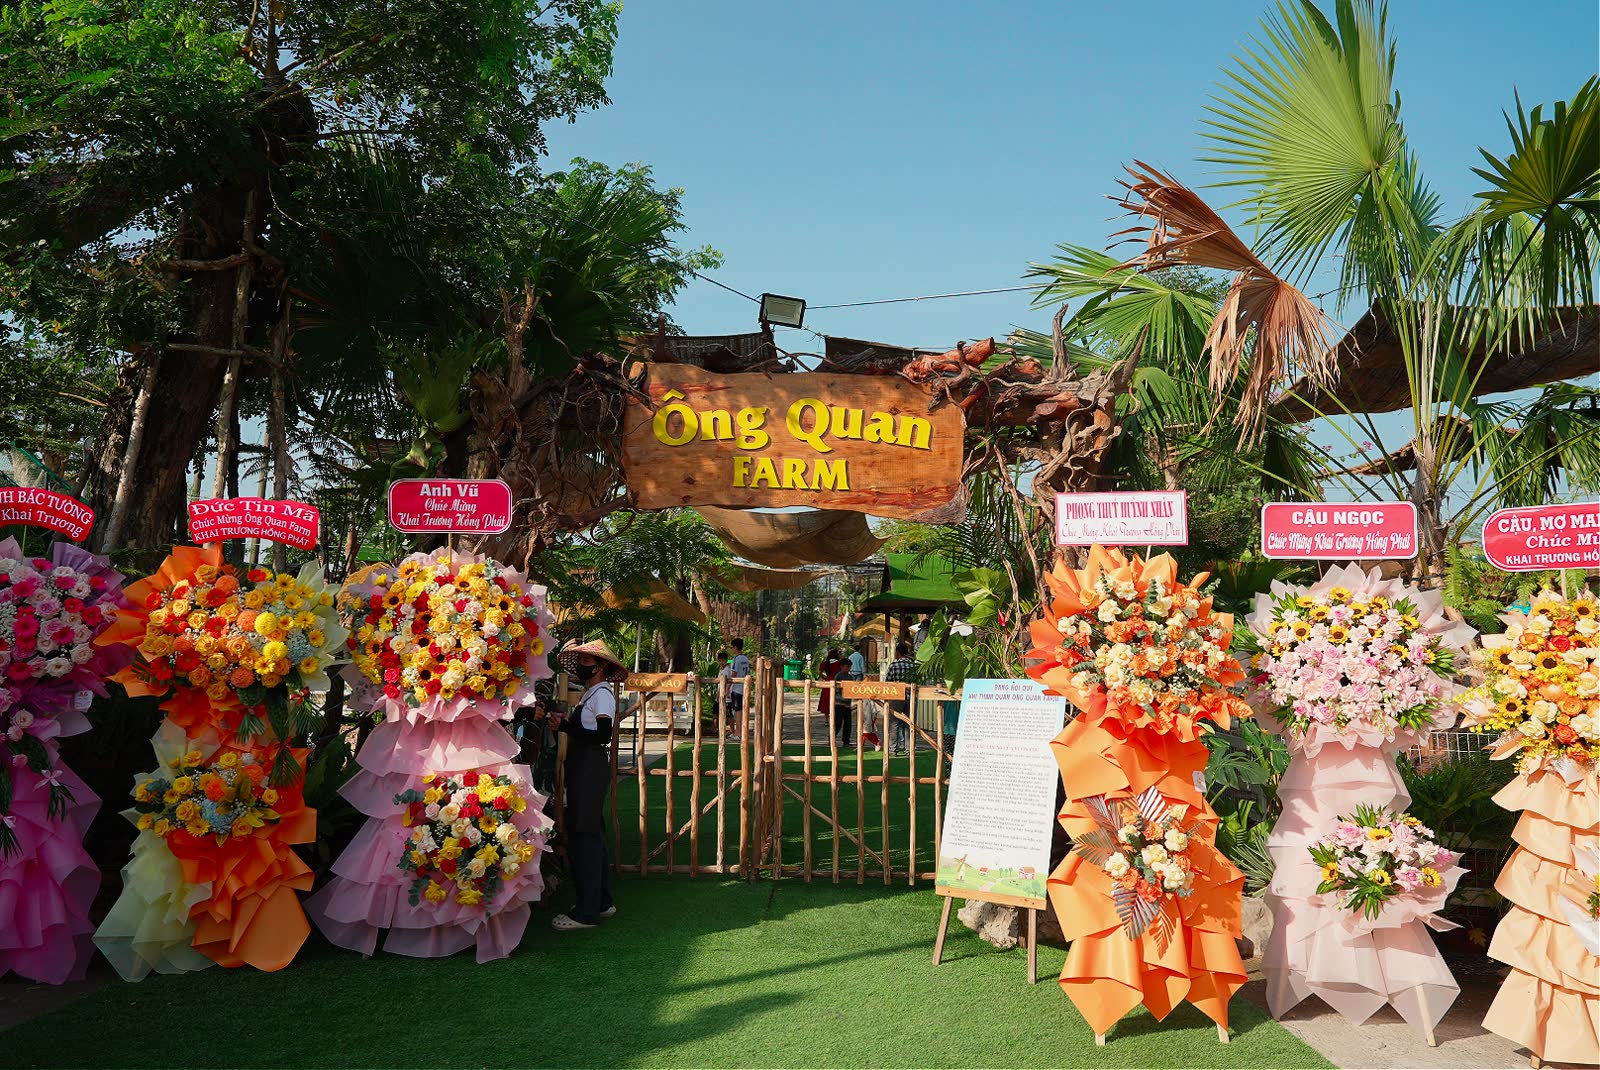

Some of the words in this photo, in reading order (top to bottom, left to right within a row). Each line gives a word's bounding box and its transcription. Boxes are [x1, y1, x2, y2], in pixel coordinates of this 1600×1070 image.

[652, 388, 770, 450] Ông
[785, 397, 932, 453] Quan
[732, 455, 850, 491] FARM
[0, 491, 14, 503] H
[18, 489, 46, 505] BÁC
[420, 483, 452, 497] Anh
[457, 483, 479, 497] Vũ
[191, 501, 235, 516] Đức
[239, 500, 275, 513] Tin
[281, 504, 317, 522] Mã
[424, 498, 448, 511] Chúc
[1, 508, 32, 520] Khai
[37, 510, 84, 538] Trương
[192, 518, 215, 531] Chúc
[244, 512, 262, 526] Ông
[264, 515, 287, 528] Quan
[288, 521, 311, 537] Farm
[397, 512, 419, 526] Khai
[482, 513, 506, 529] Phát
[1292, 509, 1328, 528] CẬU
[1334, 511, 1384, 528] NGỌC
[1498, 514, 1536, 536] CẬU,
[1540, 514, 1567, 533] MỢ
[193, 528, 219, 542] KHAI
[287, 533, 310, 546] PHÁT
[1268, 532, 1287, 550] Chúc
[1314, 532, 1335, 551] Khai
[1390, 532, 1411, 551] Phát
[1526, 533, 1571, 549] Chúc
[1505, 554, 1532, 565] KHAI
